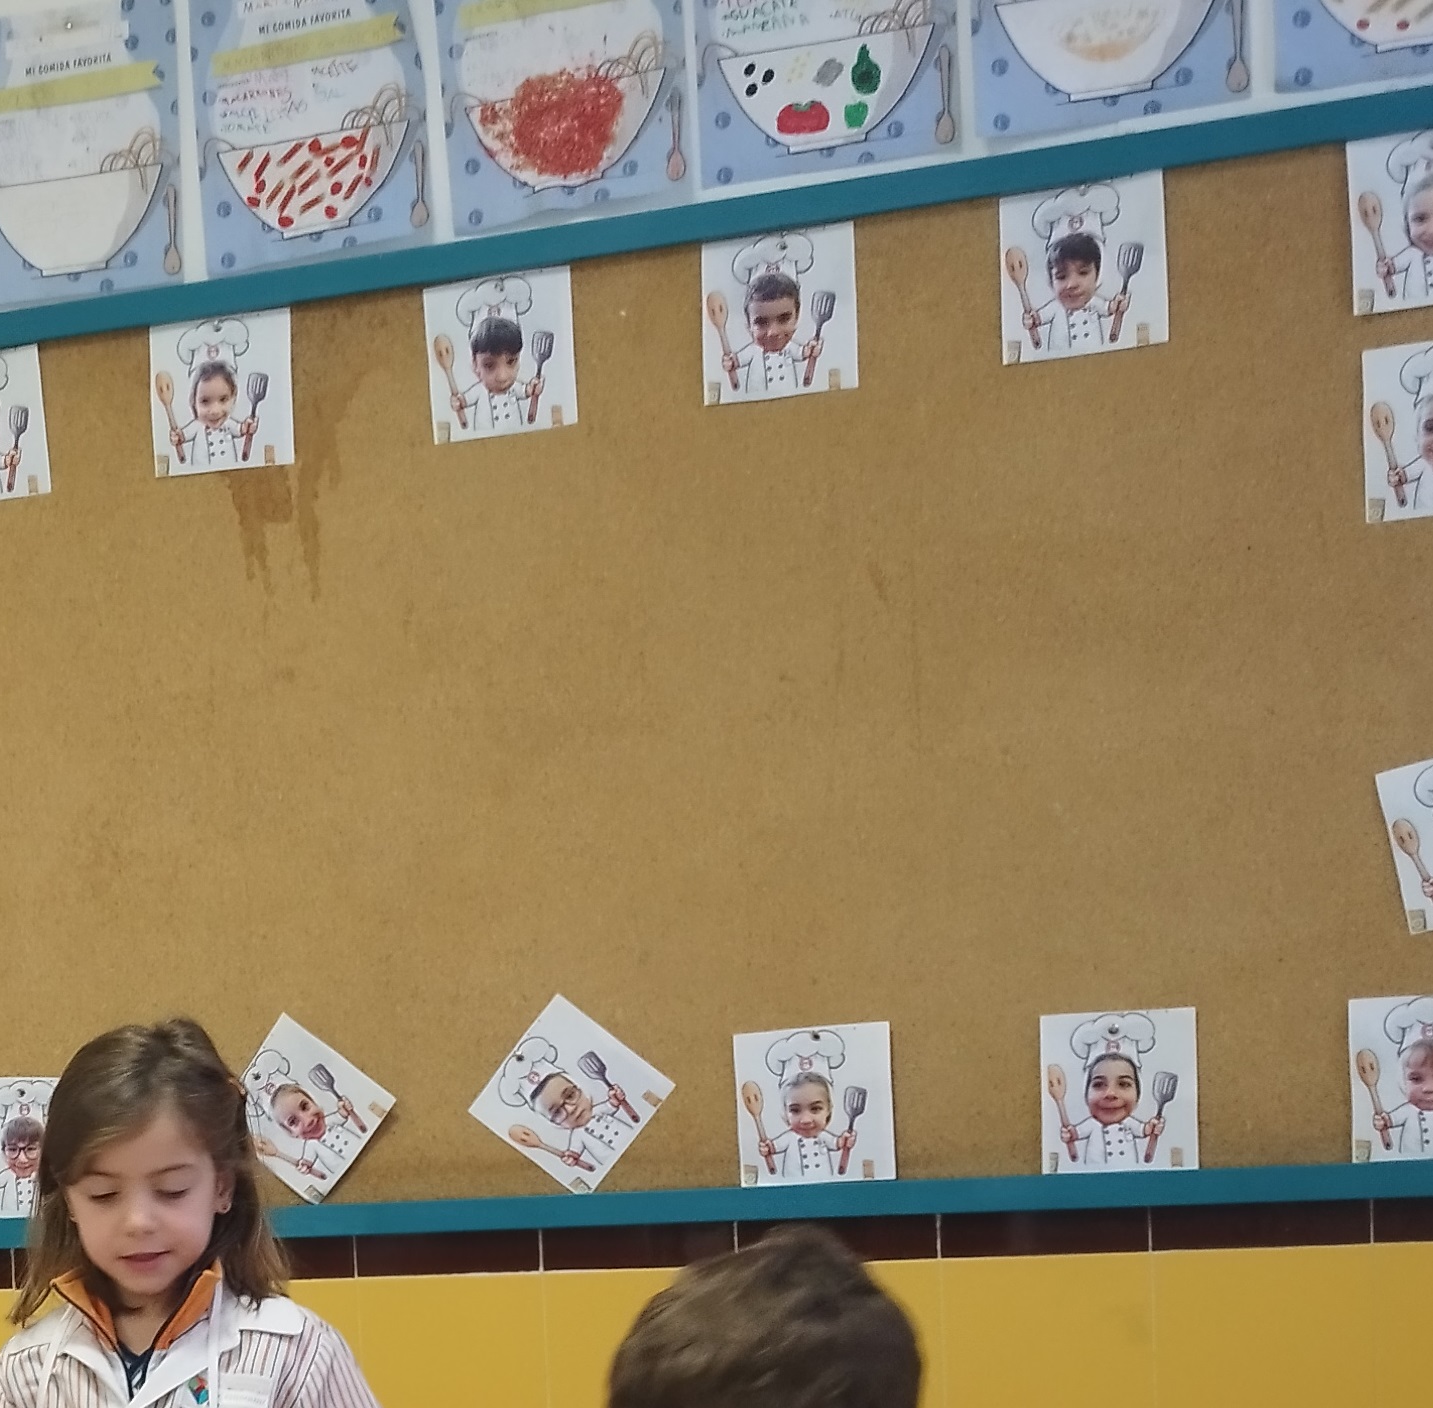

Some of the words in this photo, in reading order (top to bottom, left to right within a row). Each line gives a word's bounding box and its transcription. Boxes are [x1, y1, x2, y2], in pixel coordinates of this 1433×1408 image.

[258, 26, 269, 36] MI
[272, 18, 308, 34] COMIDA
[310, 8, 352, 26] FAVORITA
[25, 66, 36, 77] MI
[38, 59, 71, 76] COMIDA
[73, 52, 112, 69] FAVORITA
